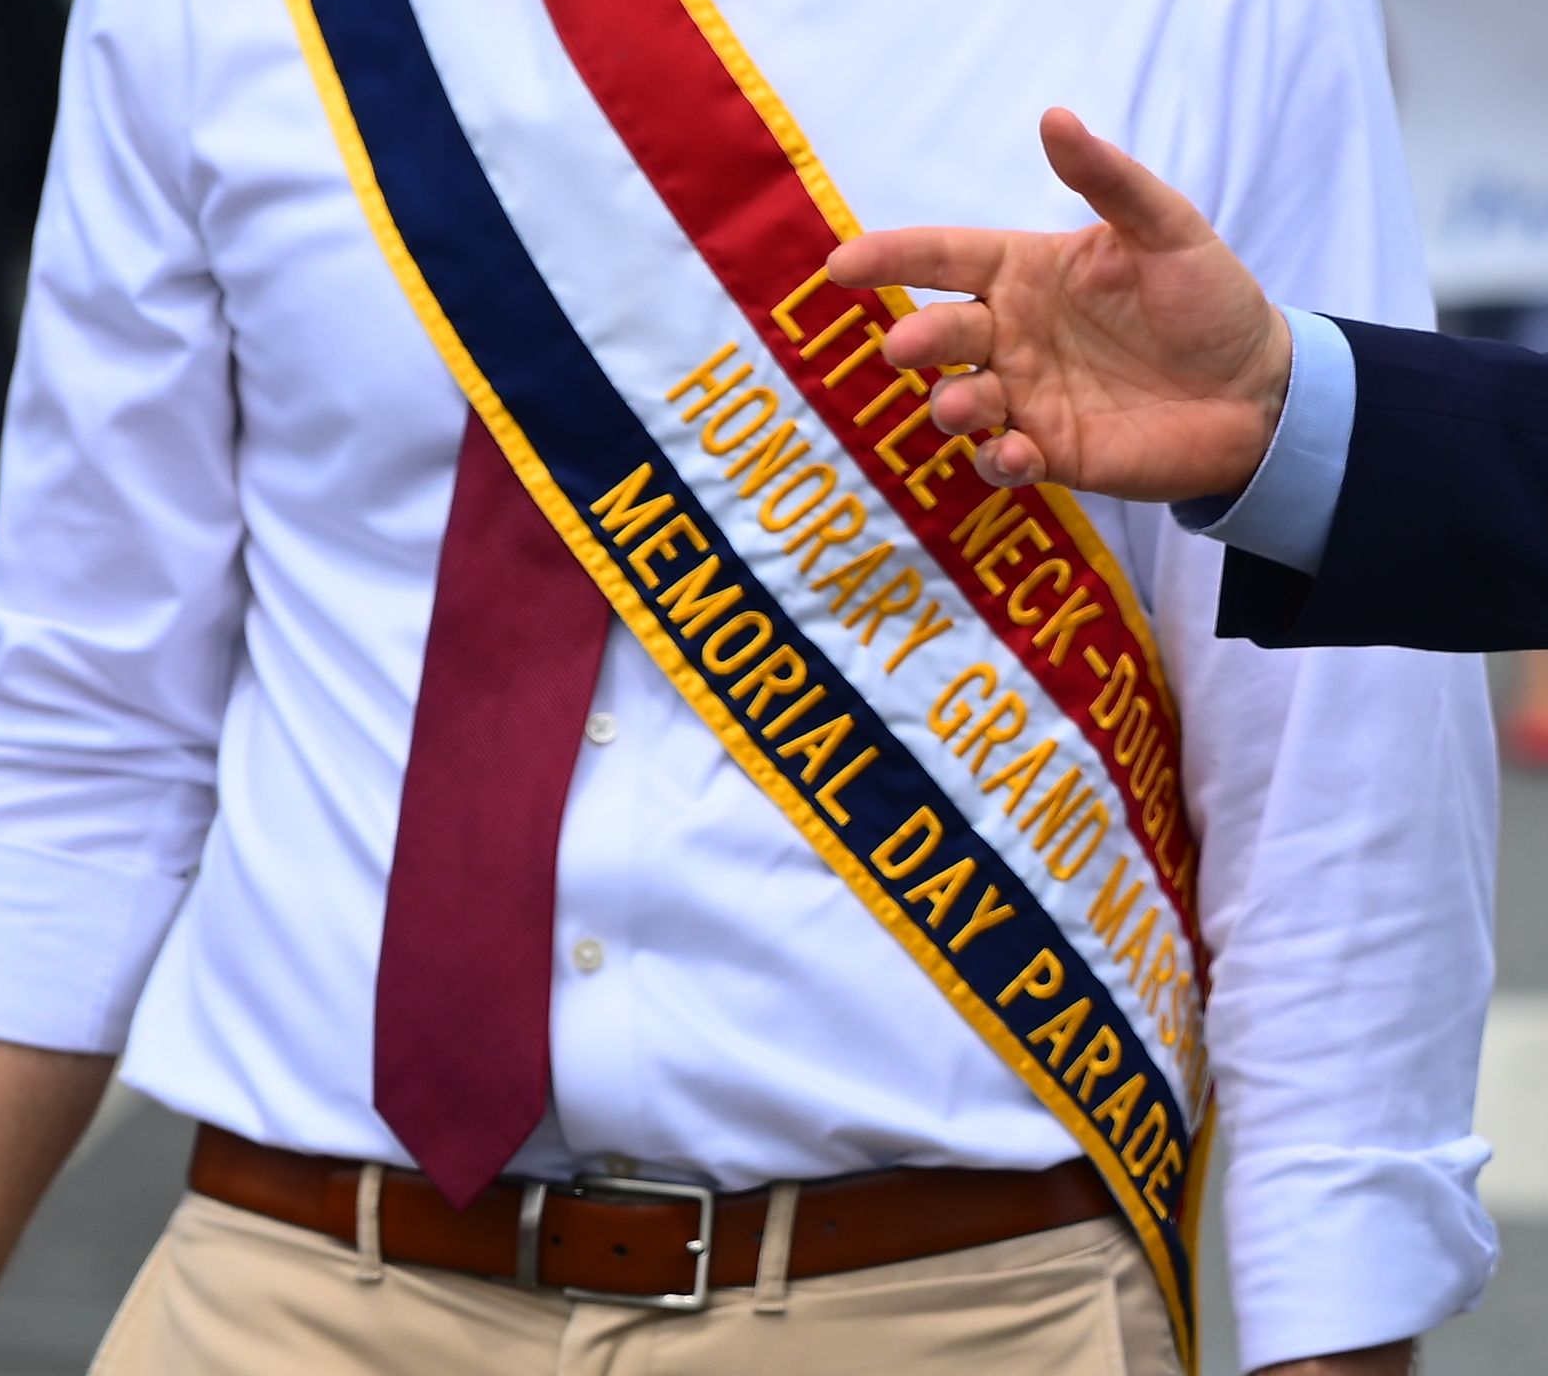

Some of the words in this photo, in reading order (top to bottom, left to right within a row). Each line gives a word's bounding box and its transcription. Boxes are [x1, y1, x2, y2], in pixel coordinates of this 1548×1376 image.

[664, 342, 953, 675] HONORARY
[926, 662, 1110, 881] GRAND
[770, 265, 978, 511] LITTLE
[589, 462, 880, 825] MEMORIAL
[868, 805, 1015, 954] DAY
[995, 947, 1183, 1221] PARADE
